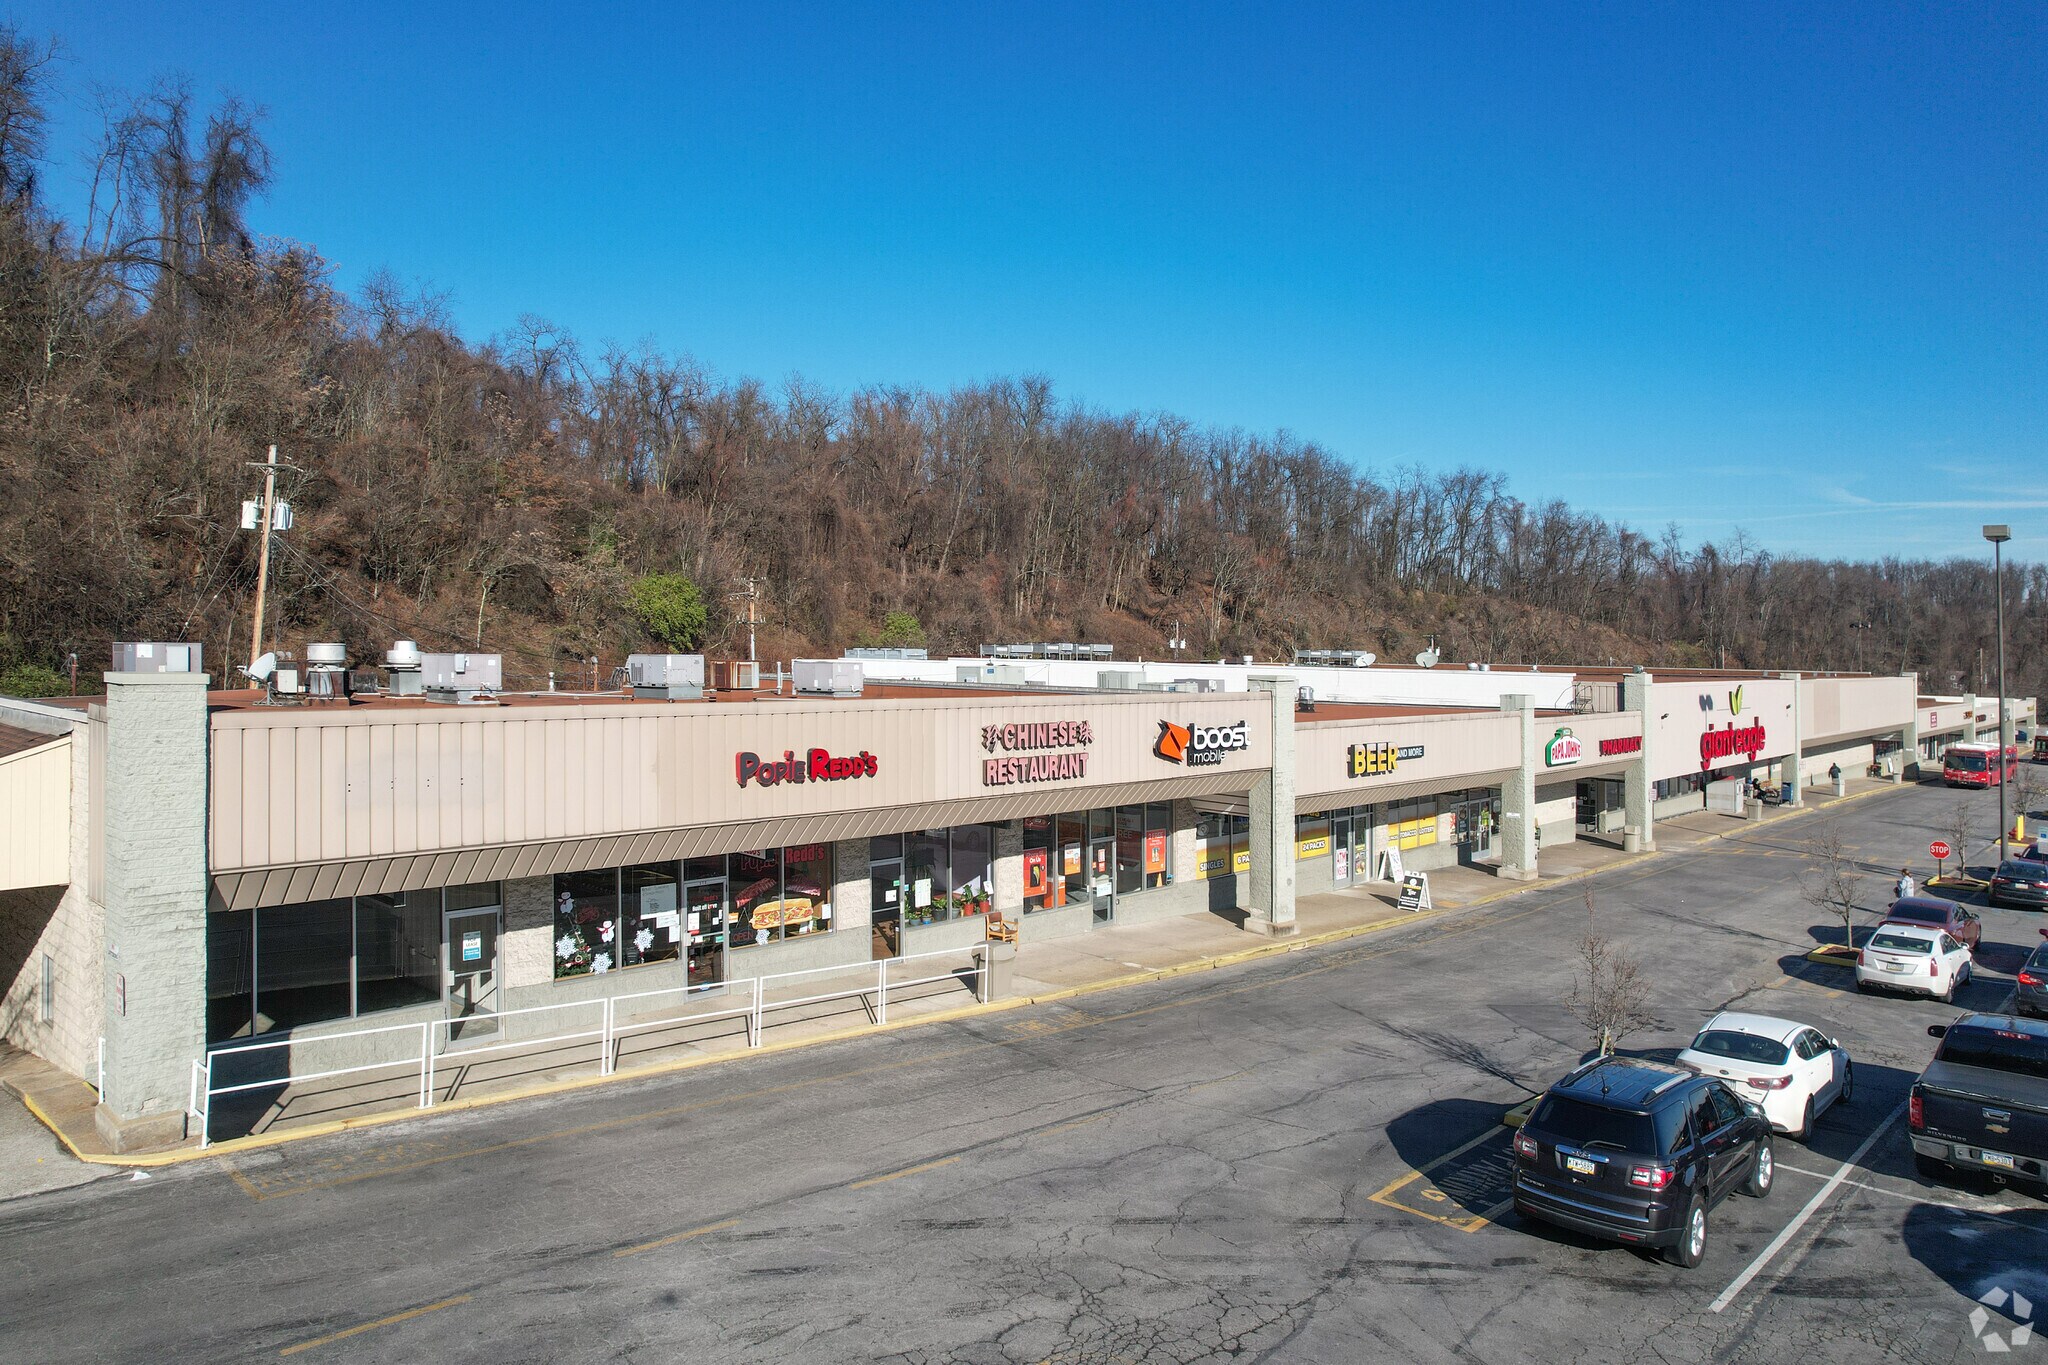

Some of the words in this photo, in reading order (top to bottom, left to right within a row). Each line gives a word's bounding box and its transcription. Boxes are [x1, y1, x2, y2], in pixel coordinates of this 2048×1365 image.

[1002, 721, 1077, 750] CHINESE
[1192, 721, 1251, 751] boost
[1700, 722, 1734, 771] giant
[1735, 717, 1765, 762] eagle
[1397, 749, 1408, 758] AND
[1408, 747, 1423, 756] MORE
[1552, 743, 1564, 760] PAPA
[1600, 736, 1643, 756] PHARMACY
[807, 748, 878, 783] REDD'S
[1193, 750, 1226, 764] mobile
[1351, 742, 1398, 776] BEER
[983, 752, 1089, 786] RESTAURANT
[1302, 843, 1309, 852] 24
[1309, 840, 1326, 850] PACKS
[1930, 845, 1949, 854] STOP
[1200, 859, 1225, 872] SINGLES
